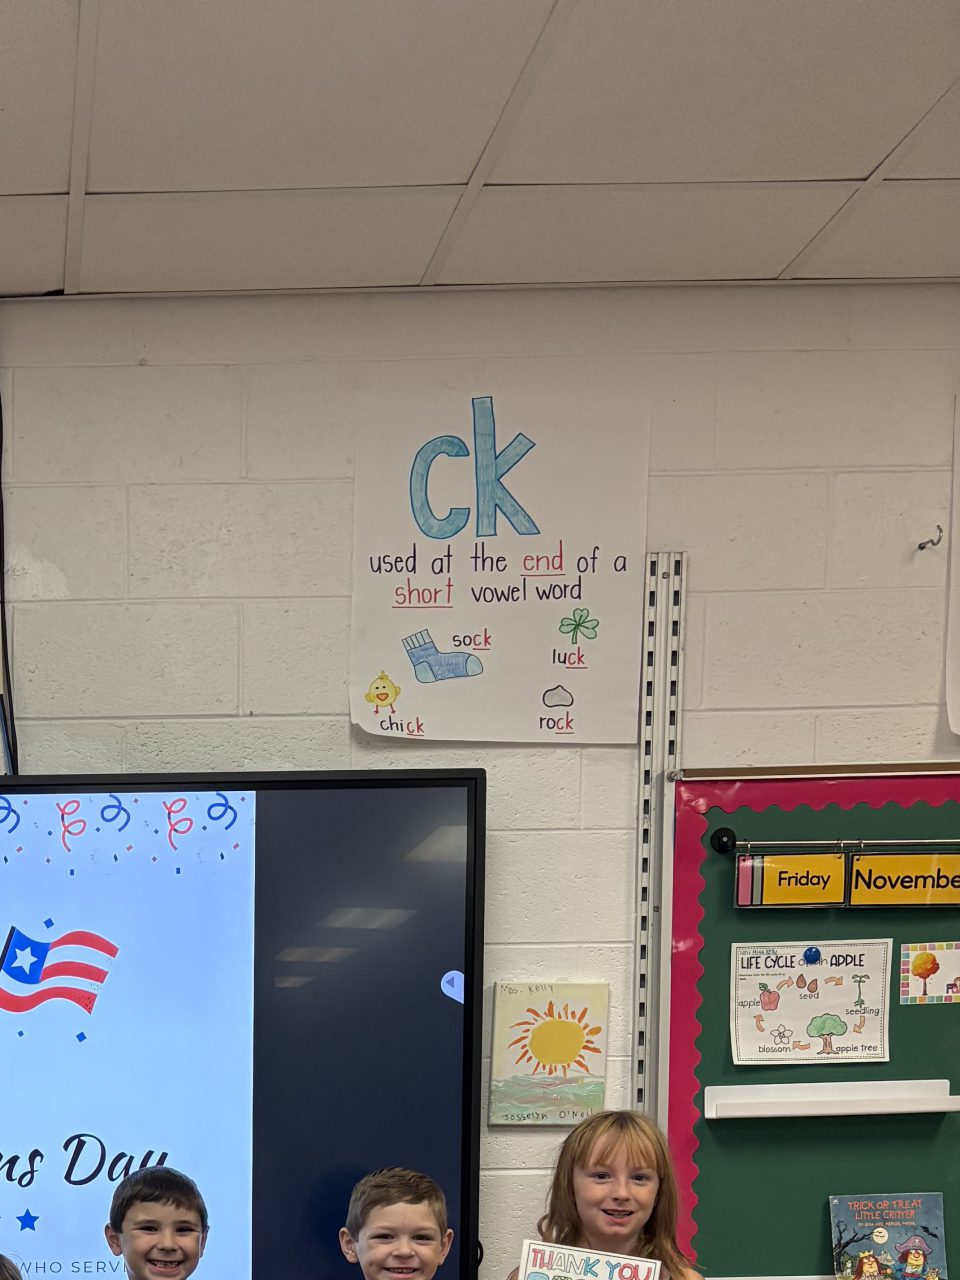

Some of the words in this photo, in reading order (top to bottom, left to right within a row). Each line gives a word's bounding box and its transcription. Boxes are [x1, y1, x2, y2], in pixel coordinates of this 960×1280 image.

[410, 396, 541, 539] ck
[370, 543, 417, 574] used
[431, 544, 453, 575] at
[470, 542, 507, 573] the
[520, 540, 566, 576] end
[577, 546, 600, 574] of
[614, 555, 627, 572] a
[392, 578, 454, 608] short
[471, 578, 527, 602] vowel
[535, 576, 582, 601] word
[452, 628, 491, 650] sock
[552, 647, 588, 669] luck
[380, 716, 425, 737] chick
[539, 715, 575, 735] rock
[778, 870, 831, 891] Friday
[854, 867, 960, 891] Novembe
[741, 956, 761, 970] LIFE
[765, 955, 796, 969] CYCLE
[830, 953, 866, 967] APPLE
[738, 999, 761, 1007] apple
[799, 991, 820, 1000] seed
[845, 1007, 880, 1017] seedling
[758, 1043, 791, 1053] blossom
[835, 1043, 859, 1053] apple
[861, 1044, 878, 1052] tree
[848, 1201, 874, 1211] TRICK
[892, 1199, 922, 1209] TREAT
[71, 1261, 126, 1273] SERV
[531, 1248, 600, 1277] THANK
